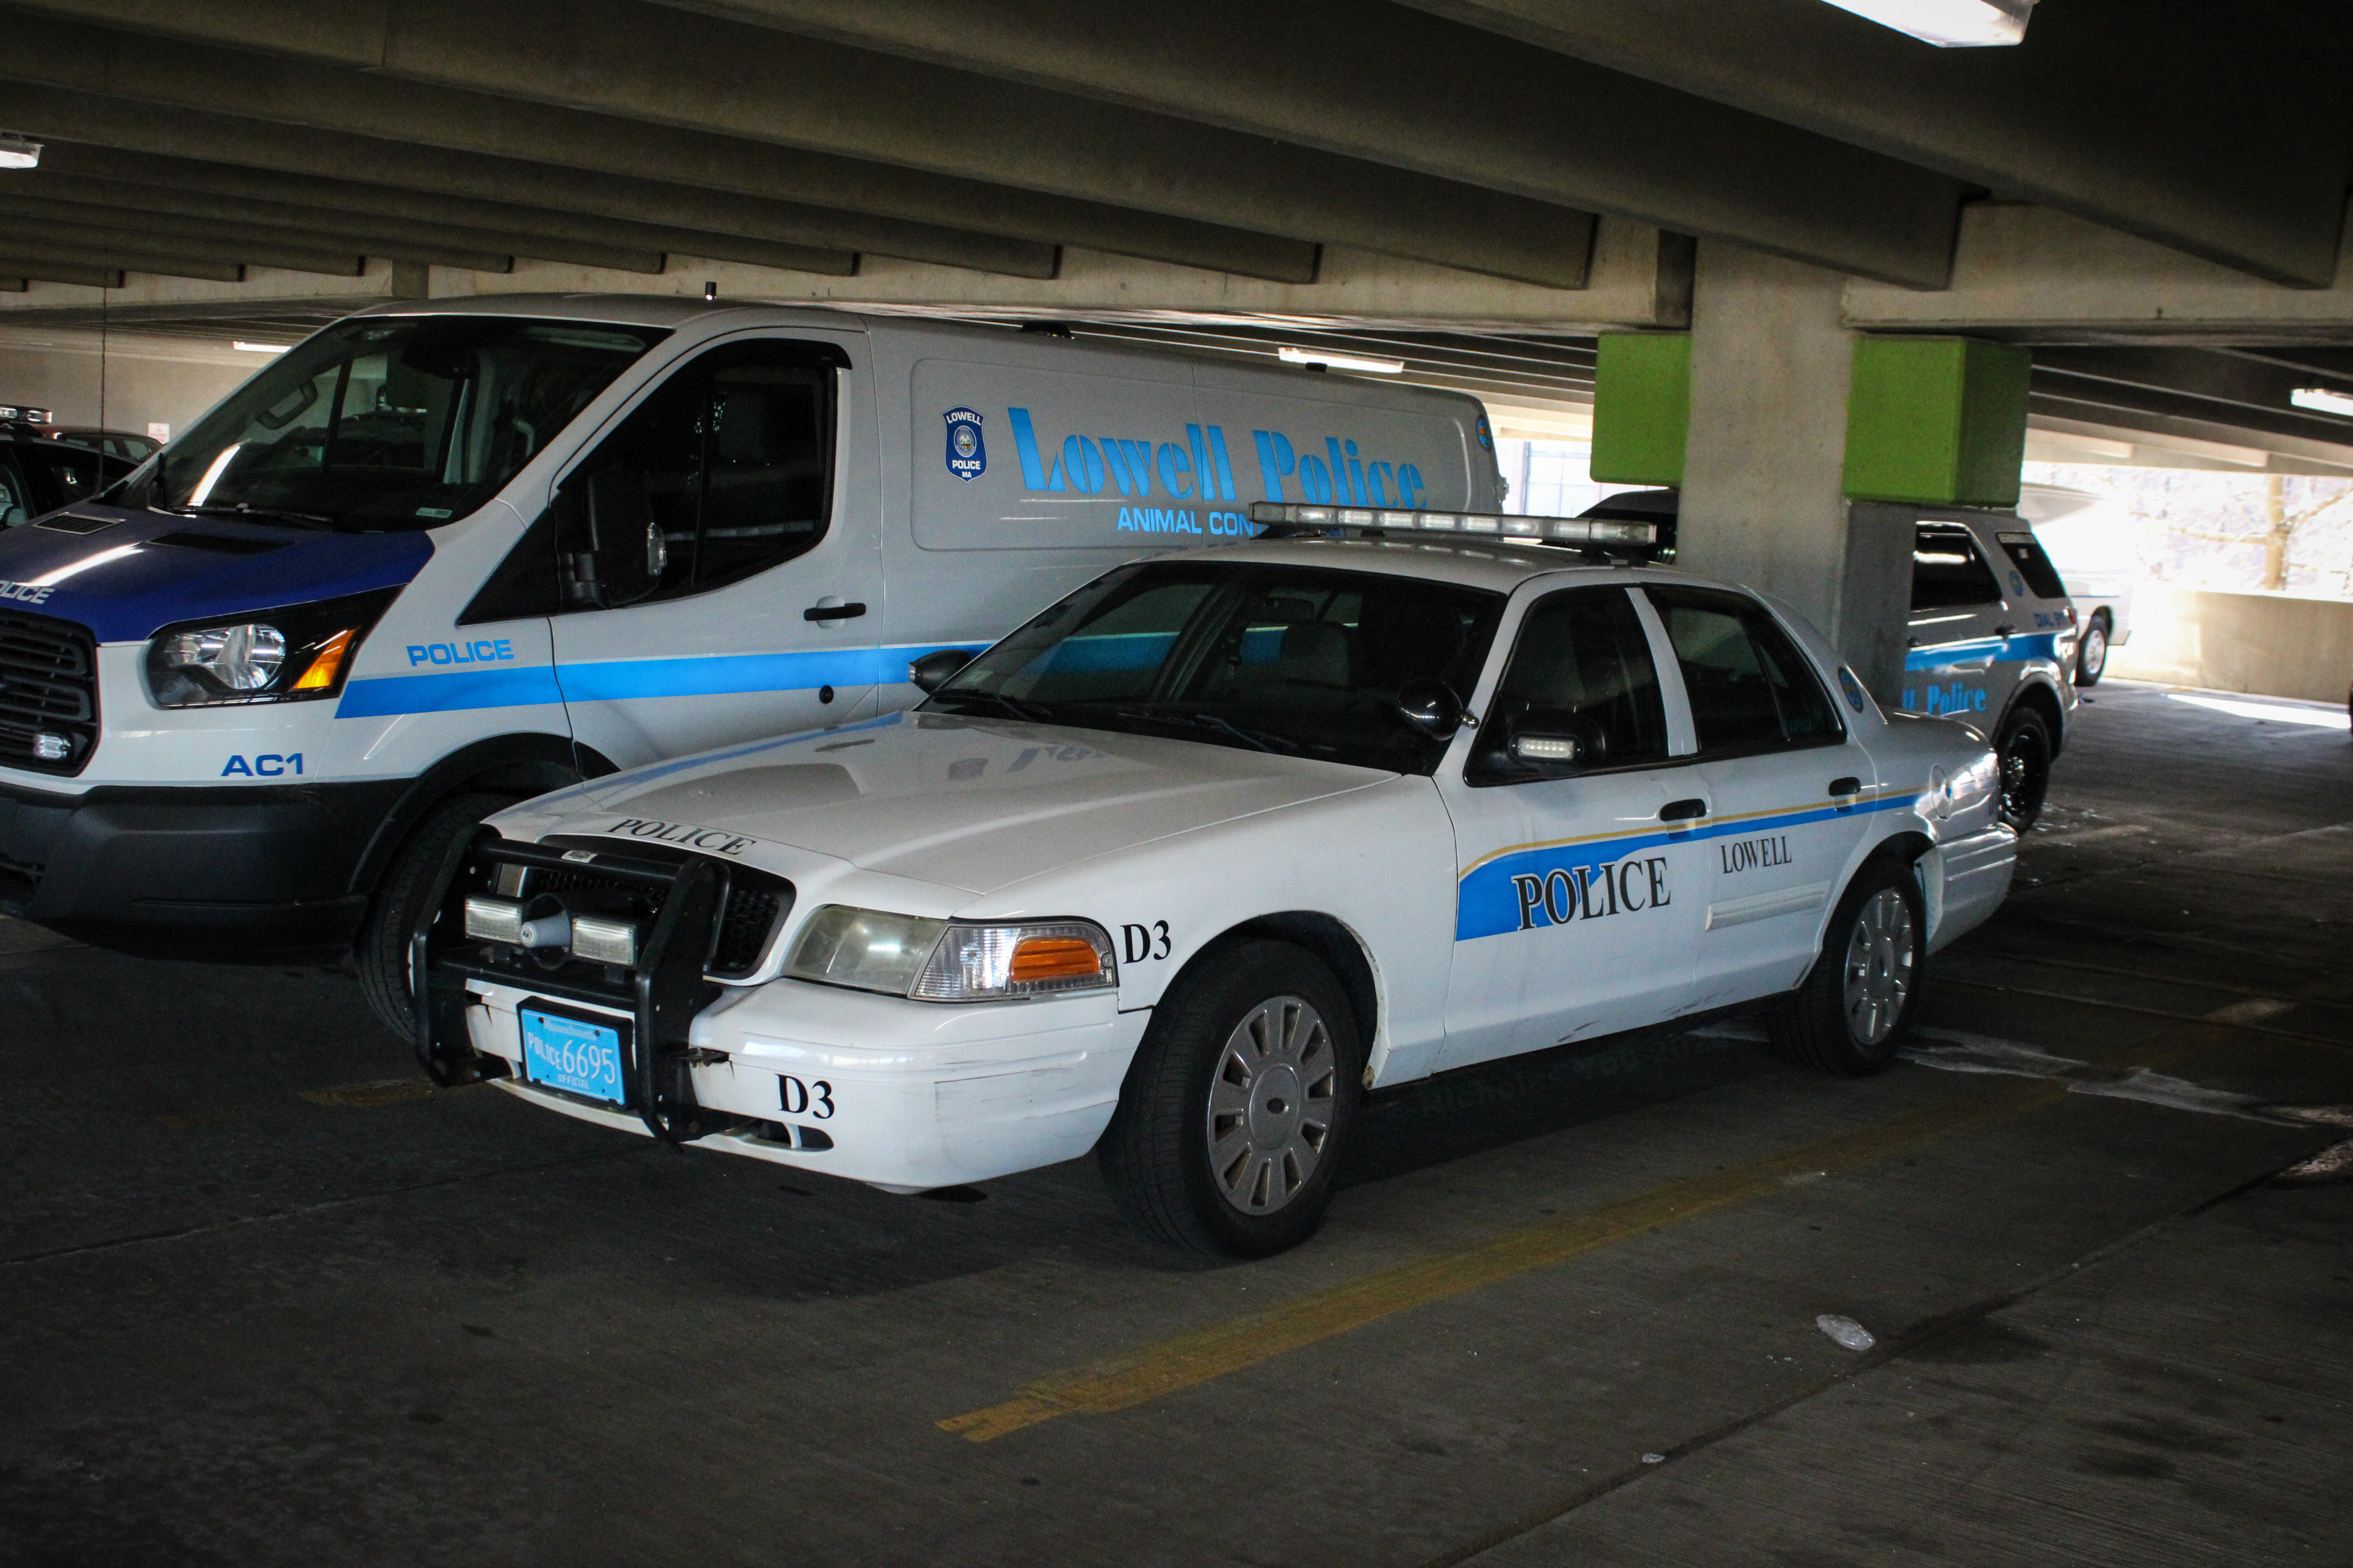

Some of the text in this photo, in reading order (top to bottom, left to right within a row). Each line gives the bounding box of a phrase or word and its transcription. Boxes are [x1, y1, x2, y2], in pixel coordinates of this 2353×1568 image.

[946, 411, 981, 426] LOWELL
[952, 459, 981, 470] POLICE
[1008, 407, 1427, 509] Lowell Police
[1117, 507, 1203, 534] ANIMAL
[406, 639, 514, 666] POLICE
[1927, 682, 1987, 714] Police
[221, 753, 303, 777] AC1
[607, 818, 757, 856] POLICE
[1720, 836, 1792, 874] LOWELL
[1512, 856, 1671, 931] POLICE
[1120, 920, 1171, 964] D3
[527, 1031, 616, 1084] POLICE 6695
[557, 1073, 591, 1090] OFFICIAL
[777, 1073, 836, 1119] D3
